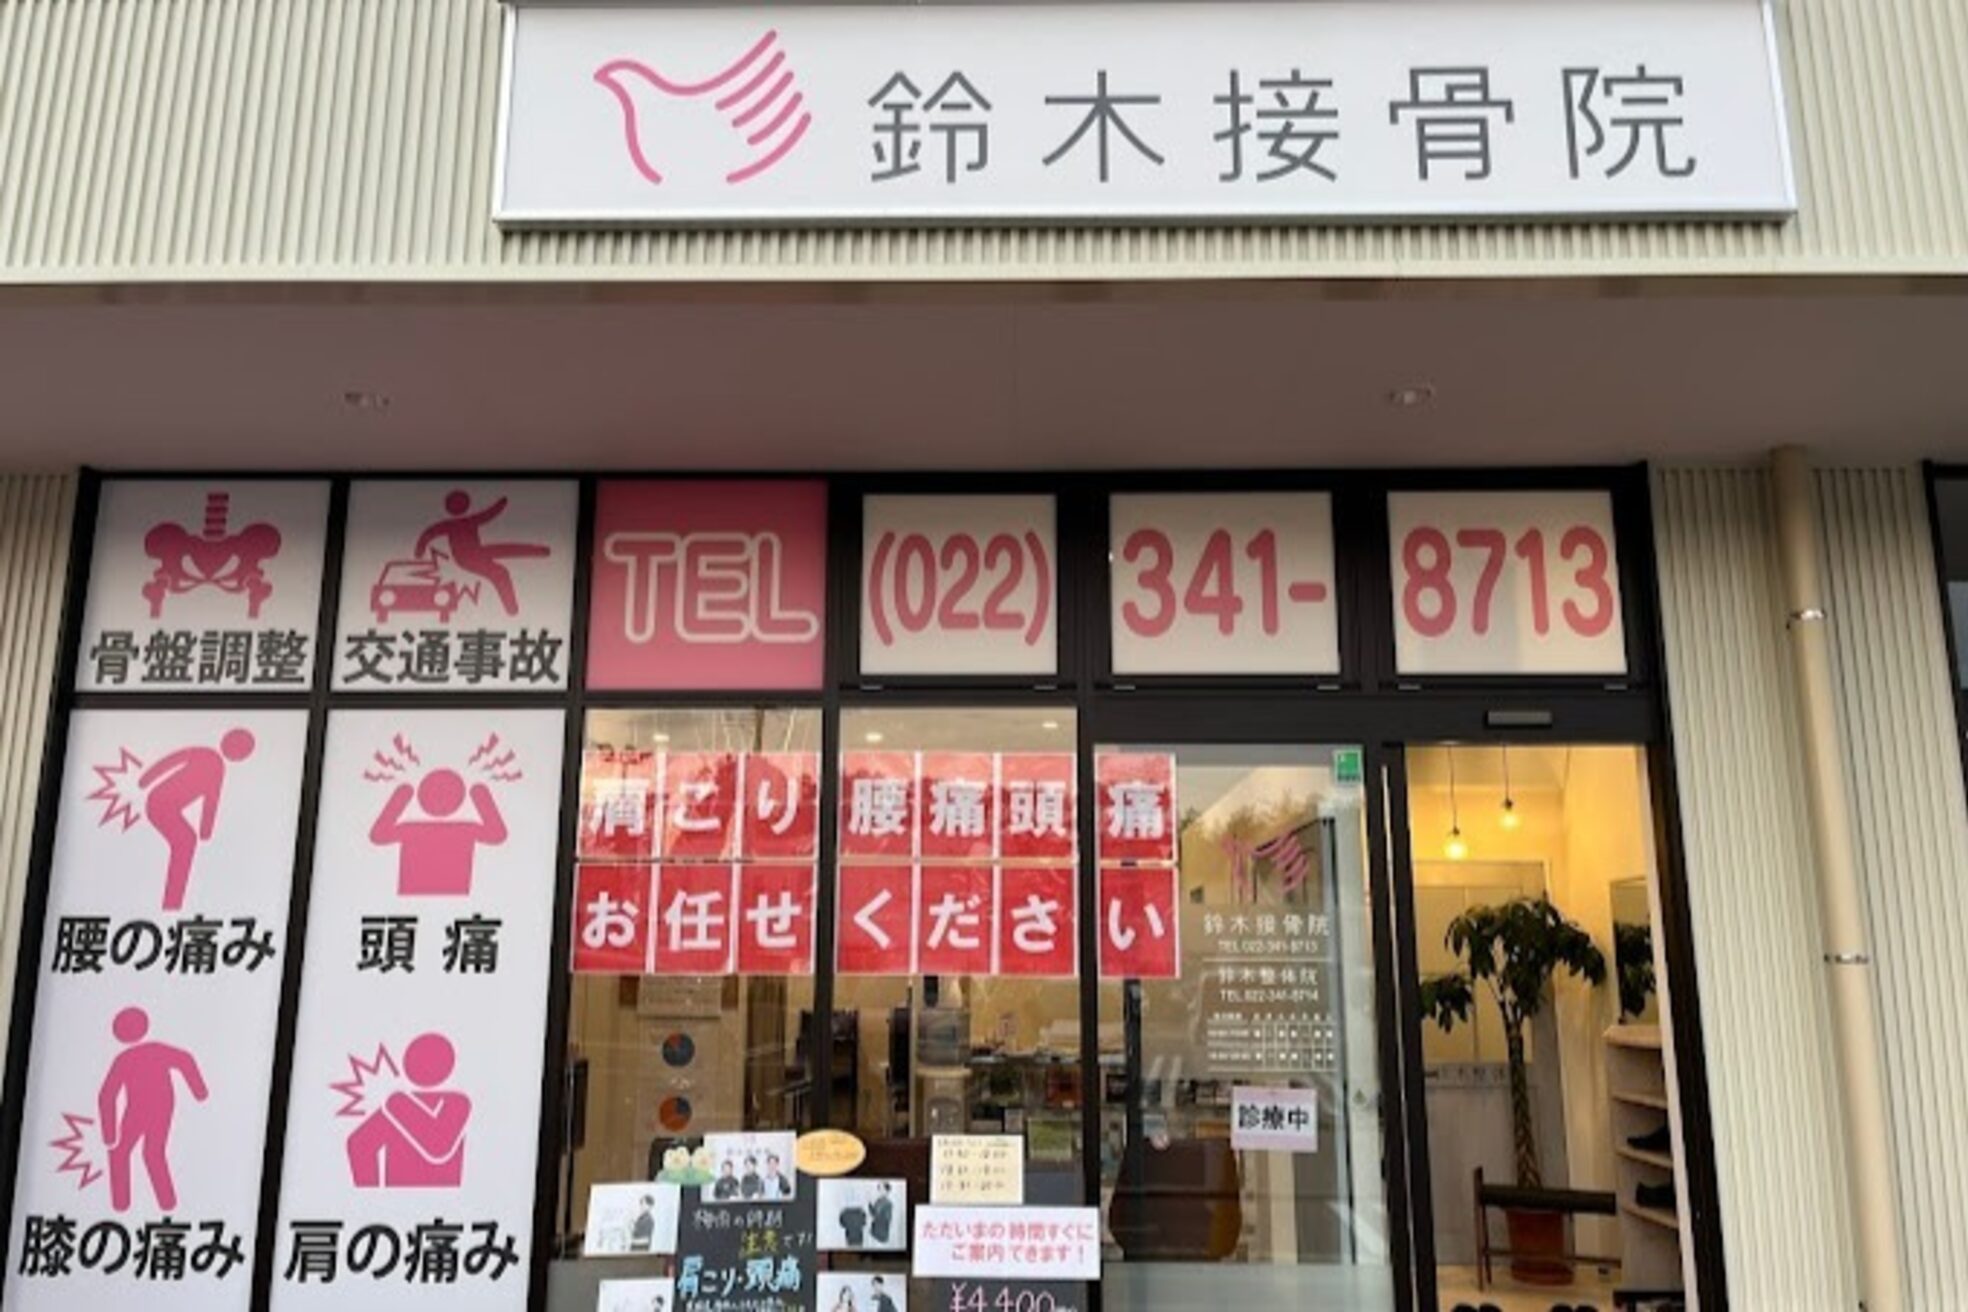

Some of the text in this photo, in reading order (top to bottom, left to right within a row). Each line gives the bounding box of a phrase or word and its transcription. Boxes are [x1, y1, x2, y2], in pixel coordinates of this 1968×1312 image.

[866, 63, 1698, 184] 鈴木接骨院
[604, 525, 1615, 646] TEL (022) 341- 8713
[89, 630, 311, 685] 骨盤調整
[343, 628, 563, 684] 交通事故
[51, 914, 276, 974] 腰の痛み
[1203, 913, 1330, 936] 鈴木接骨院
[1238, 1105, 1309, 1131] 診療中
[19, 1215, 244, 1279] 膝の痛み
[284, 1219, 519, 1283] 肩の痛み
